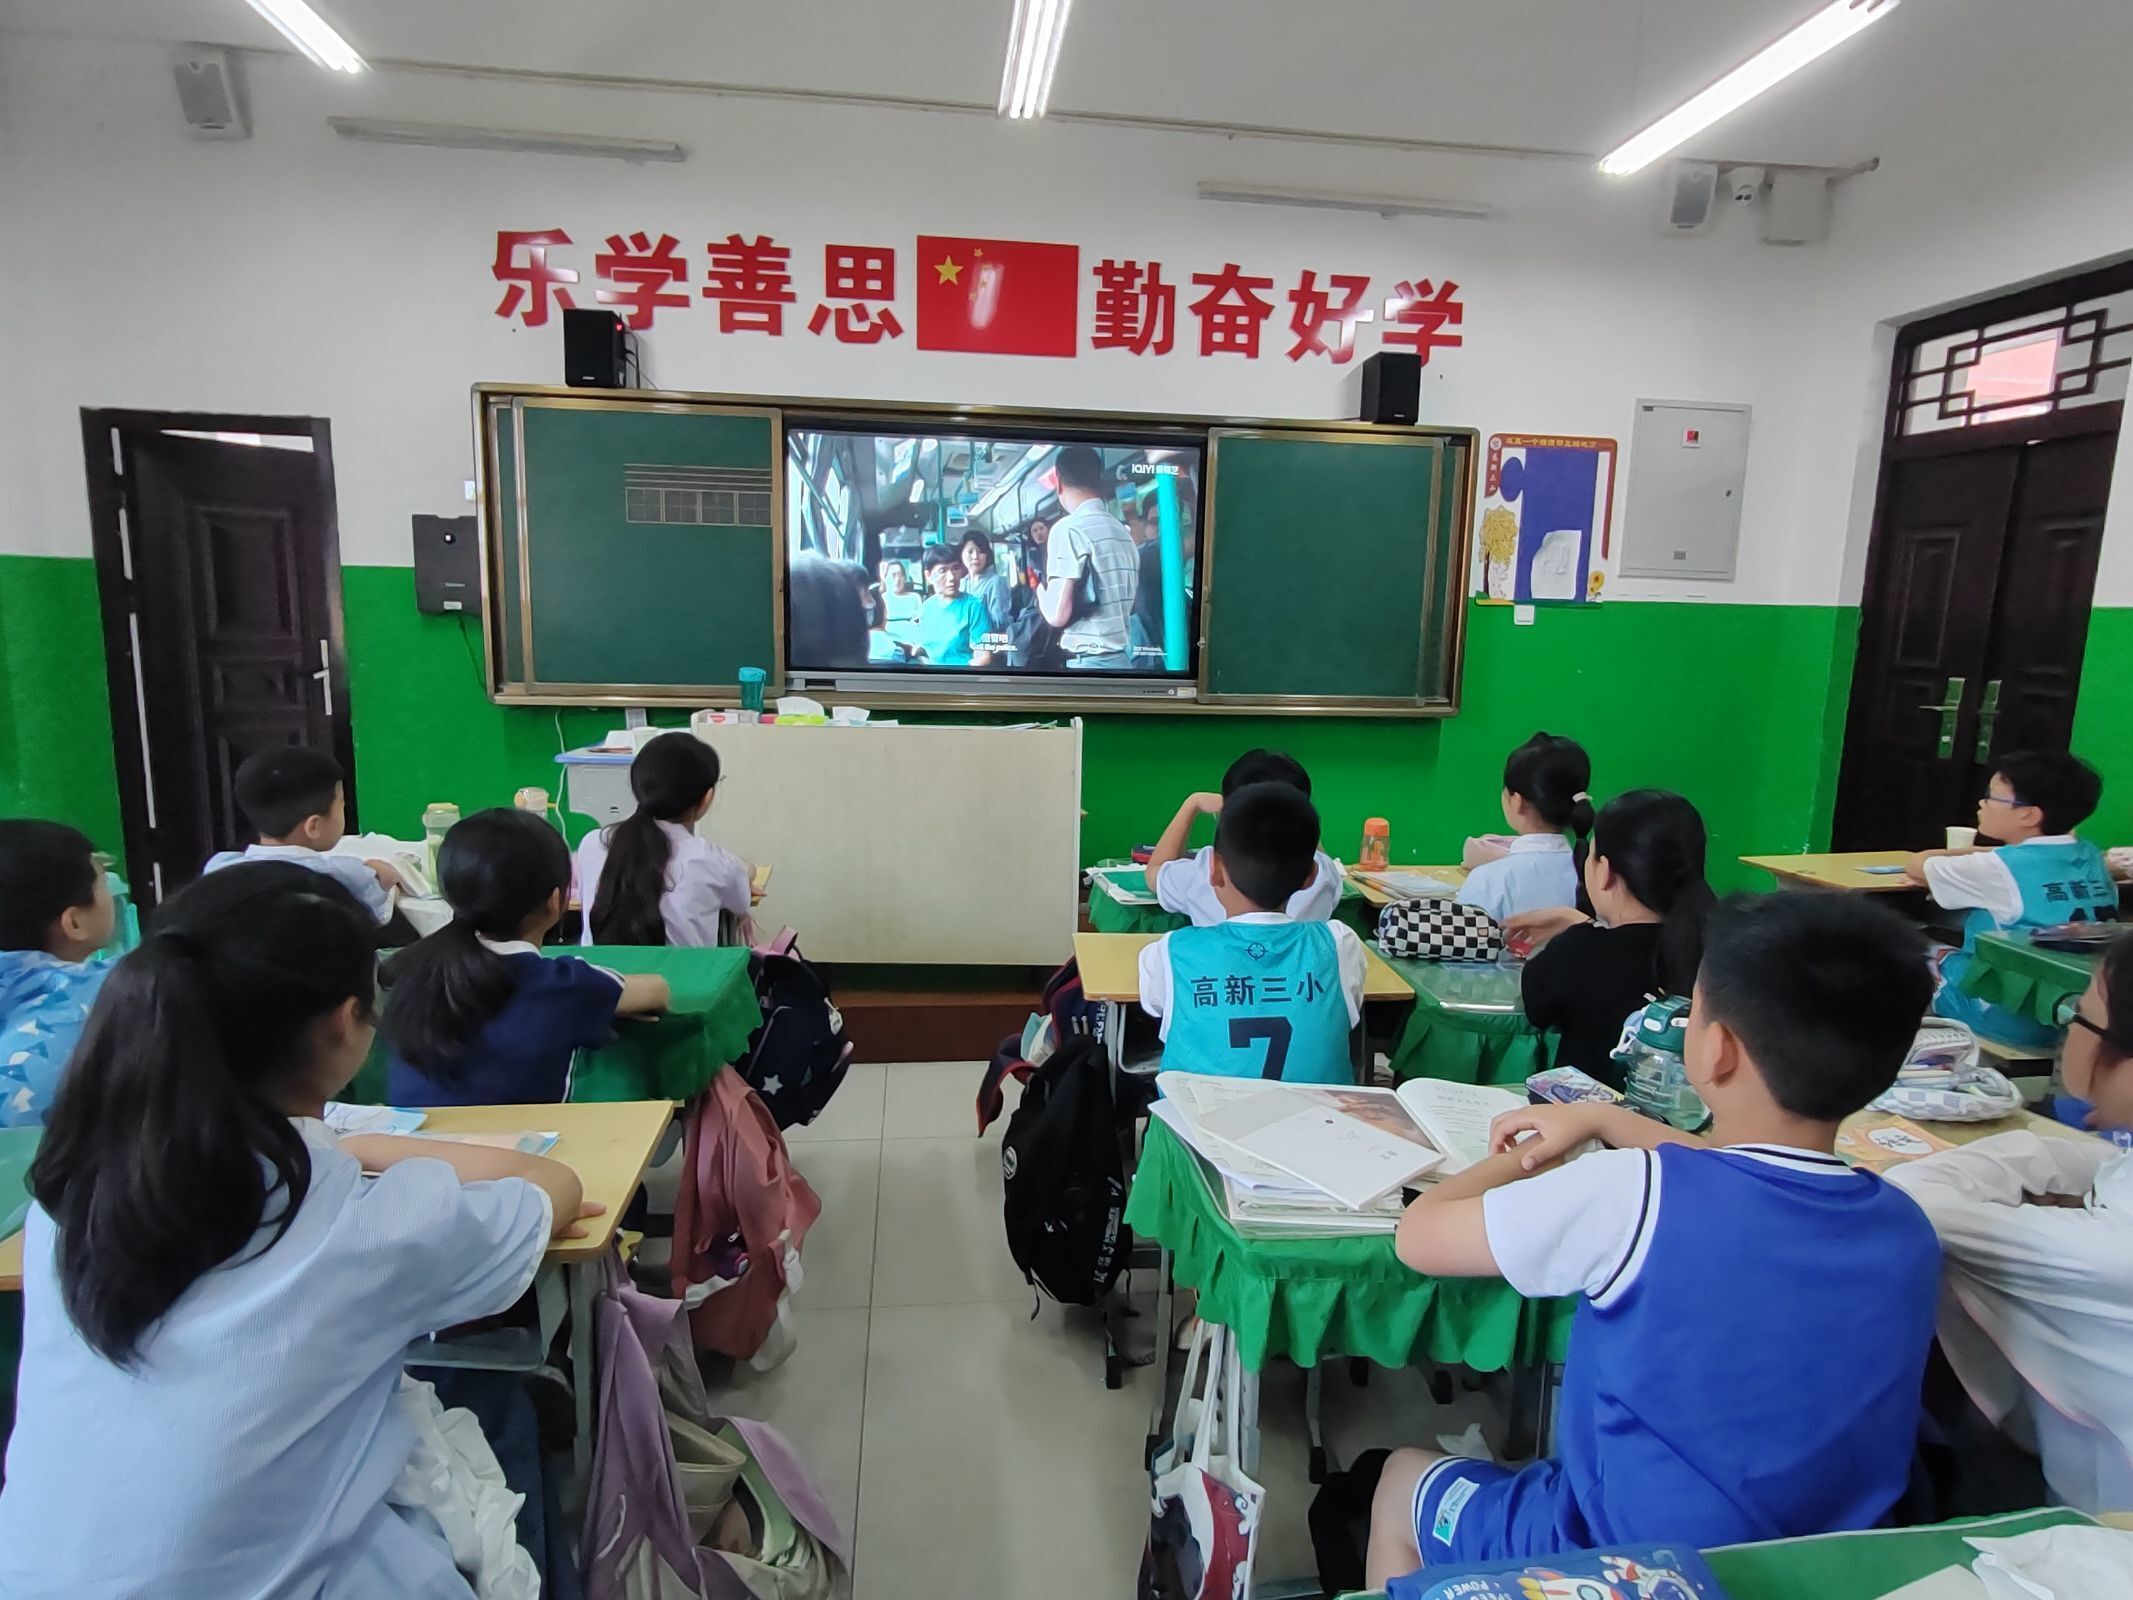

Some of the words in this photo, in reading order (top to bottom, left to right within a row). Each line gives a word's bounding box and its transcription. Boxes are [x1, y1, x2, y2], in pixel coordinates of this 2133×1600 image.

[491, 228, 904, 344] 乐学善思
[1091, 259, 1463, 366] 勤奋好学
[1191, 971, 1325, 1009] 高新三小
[1228, 1016, 1293, 1082] 7
